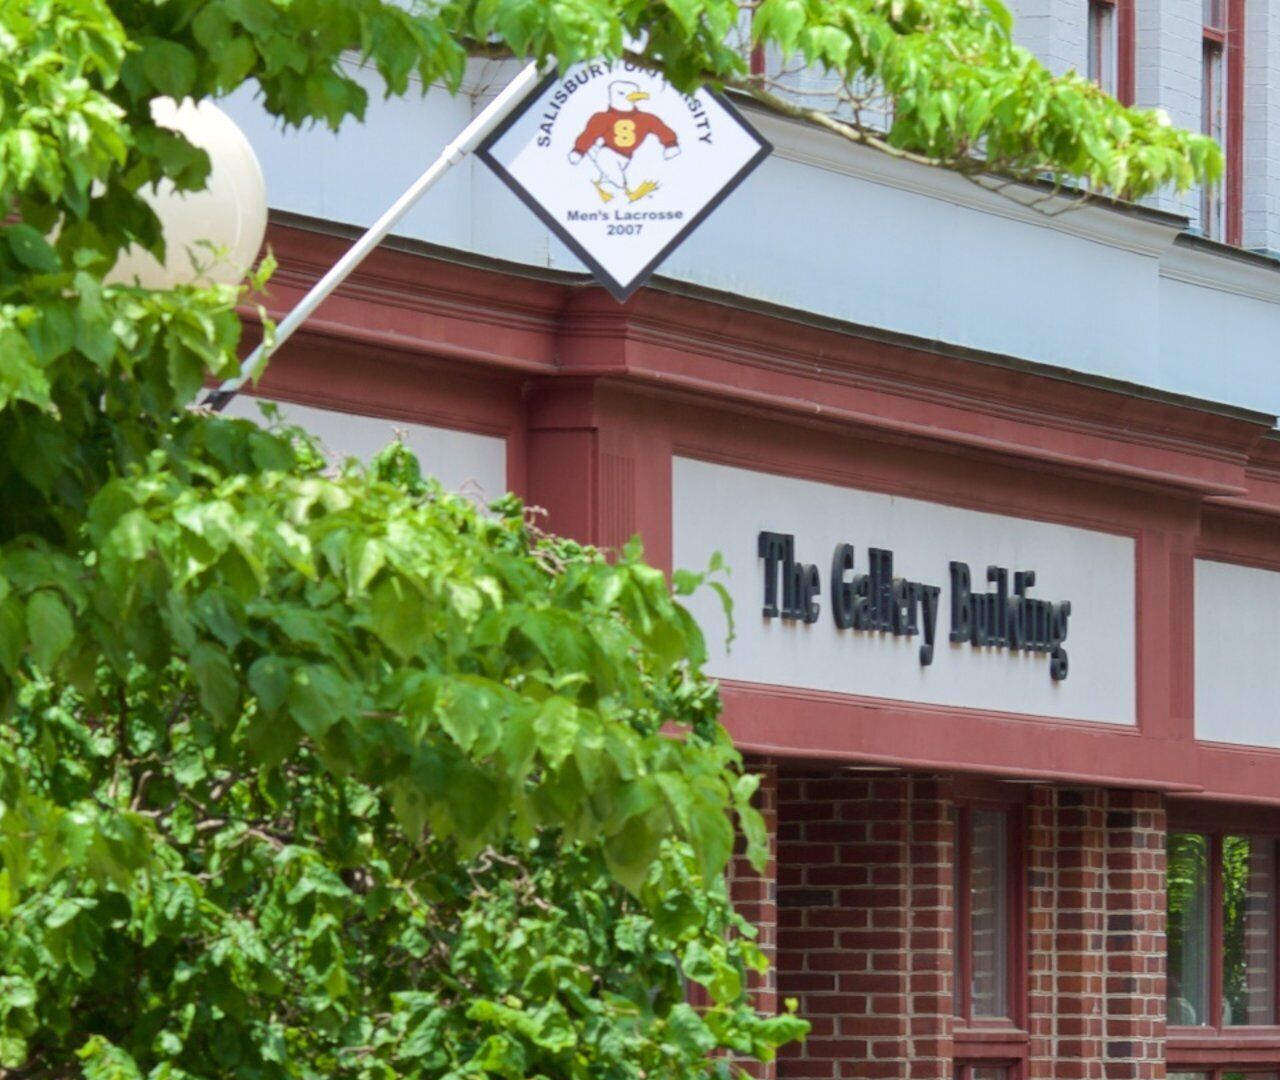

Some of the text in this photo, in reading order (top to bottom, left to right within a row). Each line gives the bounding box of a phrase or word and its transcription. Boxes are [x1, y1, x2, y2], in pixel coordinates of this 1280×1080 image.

[537, 60, 613, 147] SALISBURY
[567, 209, 684, 222] Men's Lacrosse
[606, 223, 644, 236] 2007
[757, 530, 1072, 682] The Gallery Building
